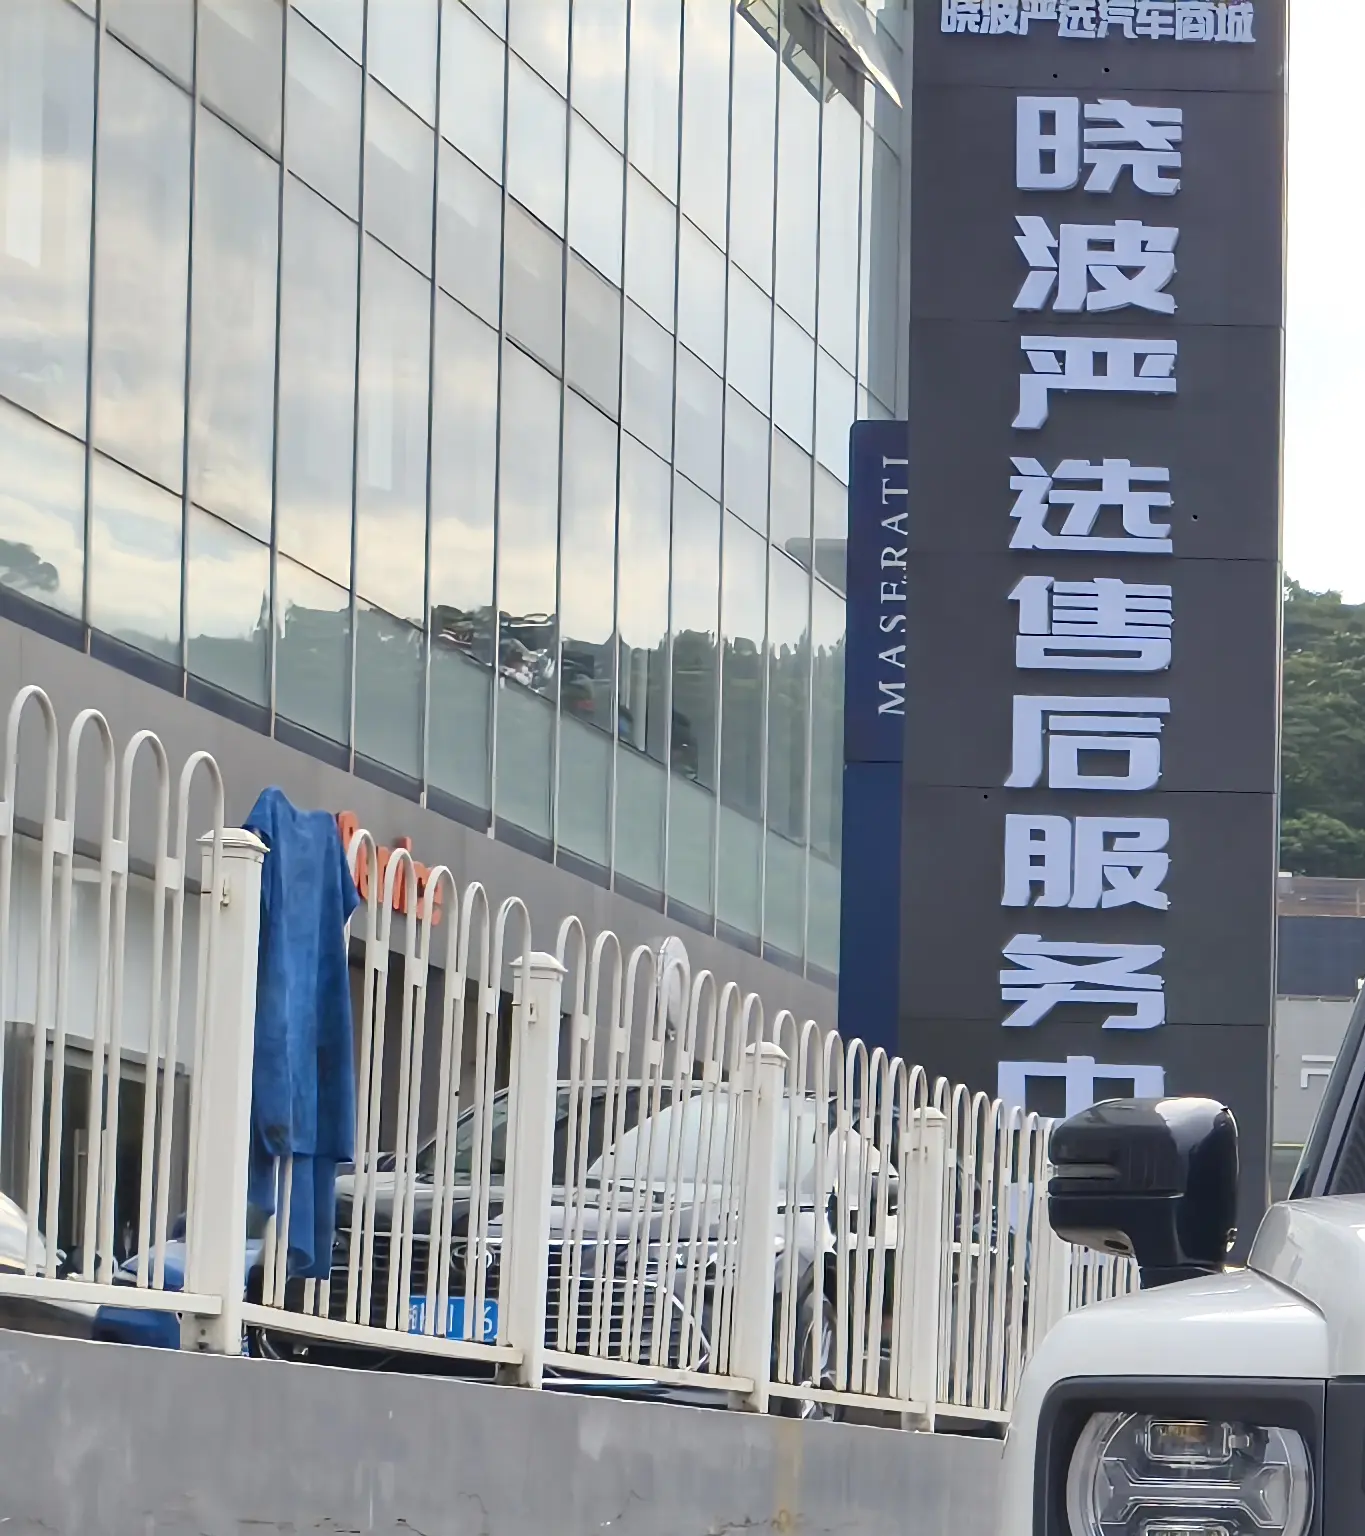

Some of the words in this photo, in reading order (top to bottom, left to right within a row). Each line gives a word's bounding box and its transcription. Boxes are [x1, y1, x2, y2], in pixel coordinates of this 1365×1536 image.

[940, 0, 1257, 43] 晓波严选汽车商城
[877, 455, 909, 717] MASERATI
